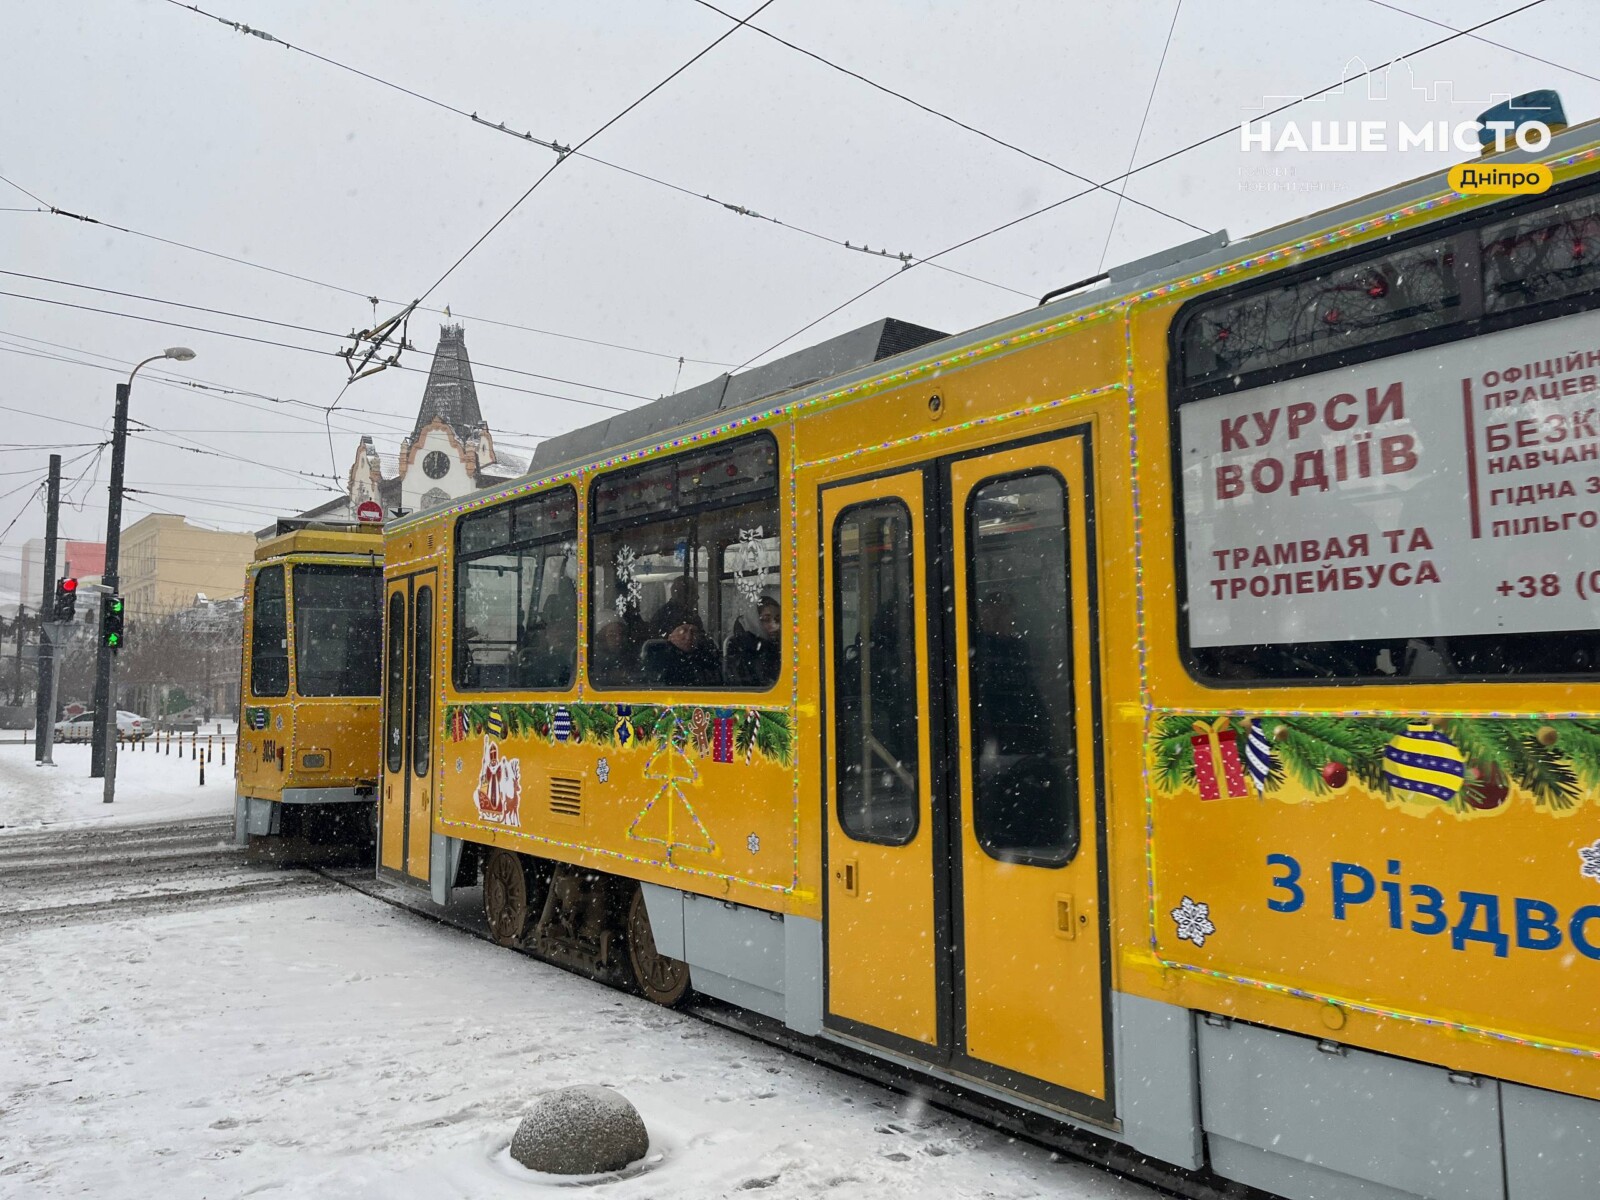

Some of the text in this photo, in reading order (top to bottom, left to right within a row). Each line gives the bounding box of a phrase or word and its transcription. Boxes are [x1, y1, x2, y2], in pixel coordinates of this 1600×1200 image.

[1220, 382, 1404, 452] КУРСИ
[1486, 408, 1600, 453] БЕЗК
[1216, 432, 1419, 500] ВОДІЇВ
[1488, 444, 1599, 475] НАВЧАН
[1490, 480, 1576, 506] ГІДНА
[1493, 511, 1598, 538] ПІЛЬГО
[1213, 527, 1433, 571] ТРАМВАЯ ТА
[1210, 560, 1441, 600] ТРОЛЕЙБУСА
[1496, 573, 1561, 598] +38
[1332, 860, 1600, 960] Різдво
